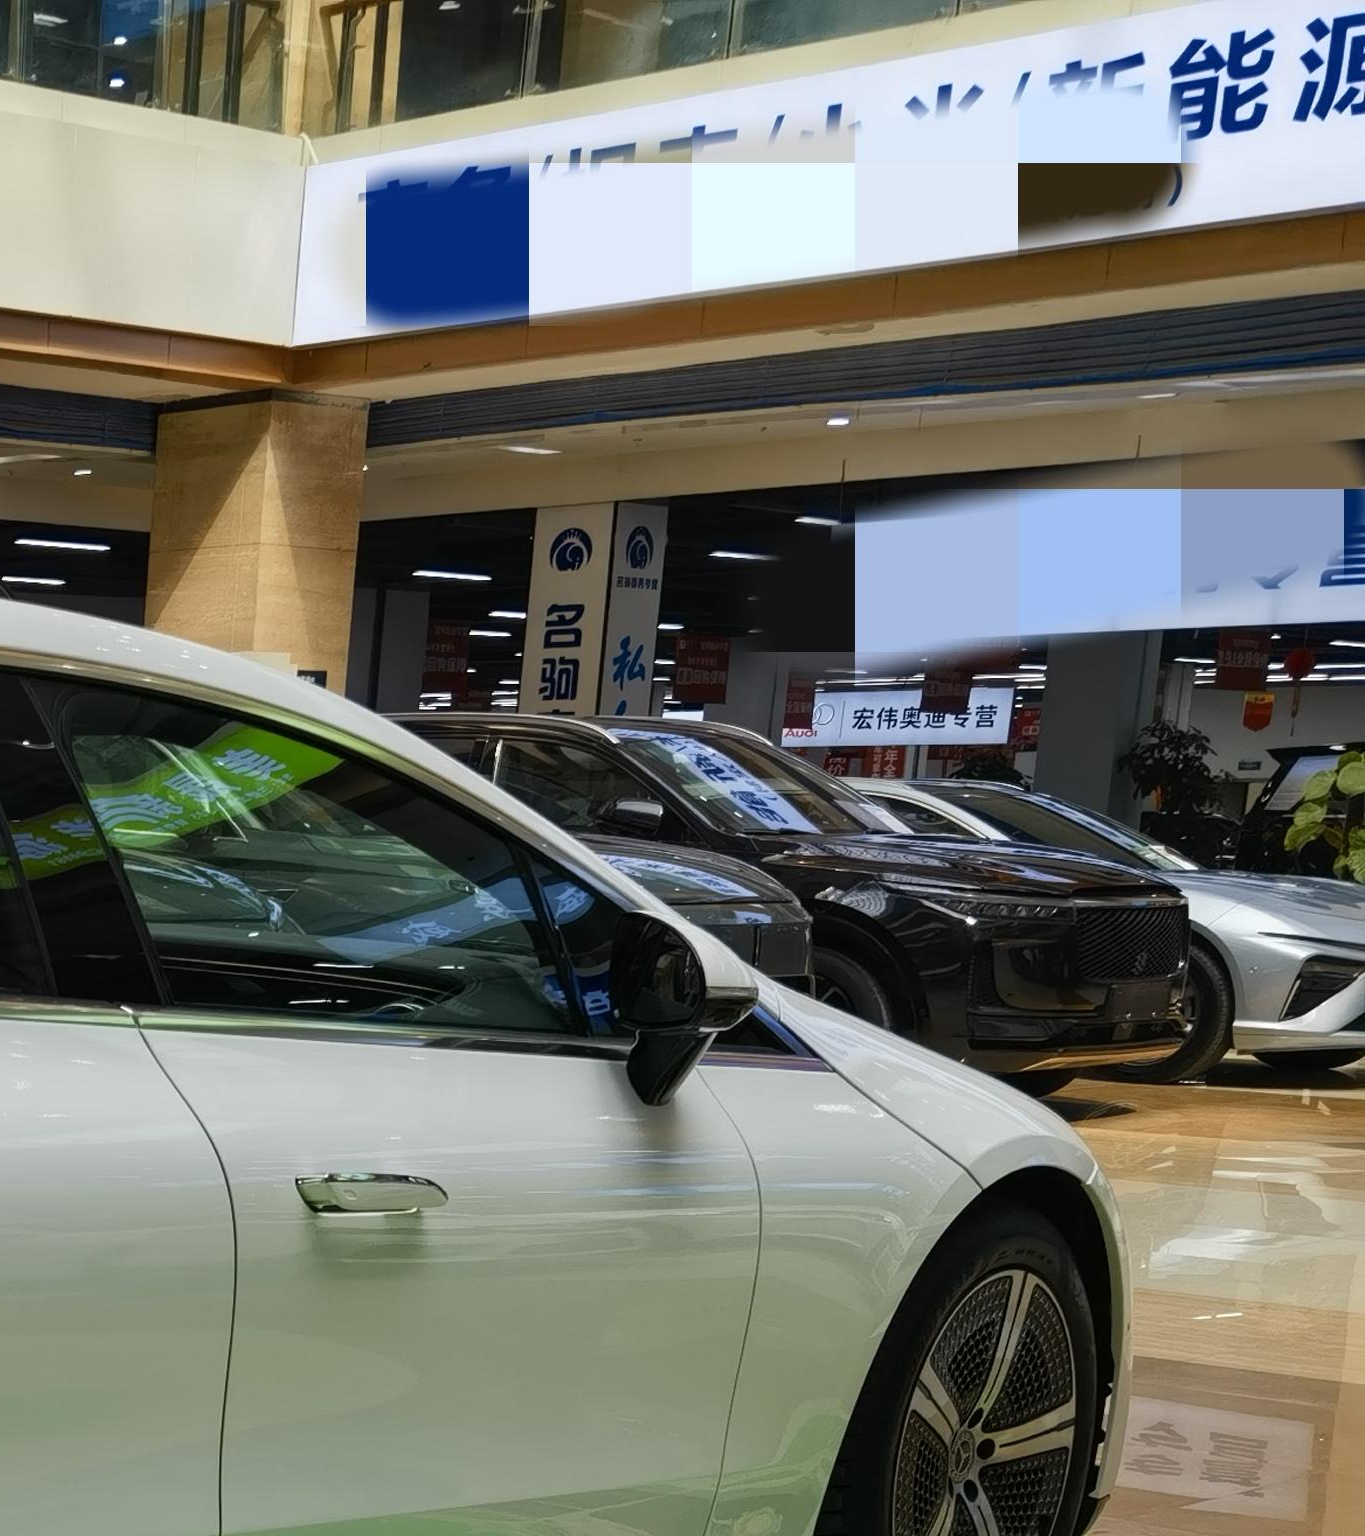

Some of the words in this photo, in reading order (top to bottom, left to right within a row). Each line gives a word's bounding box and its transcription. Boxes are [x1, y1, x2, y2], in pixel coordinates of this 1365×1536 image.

[538, 603, 586, 716] 名驹
[852, 704, 998, 730] 宏伟奥迪专营
